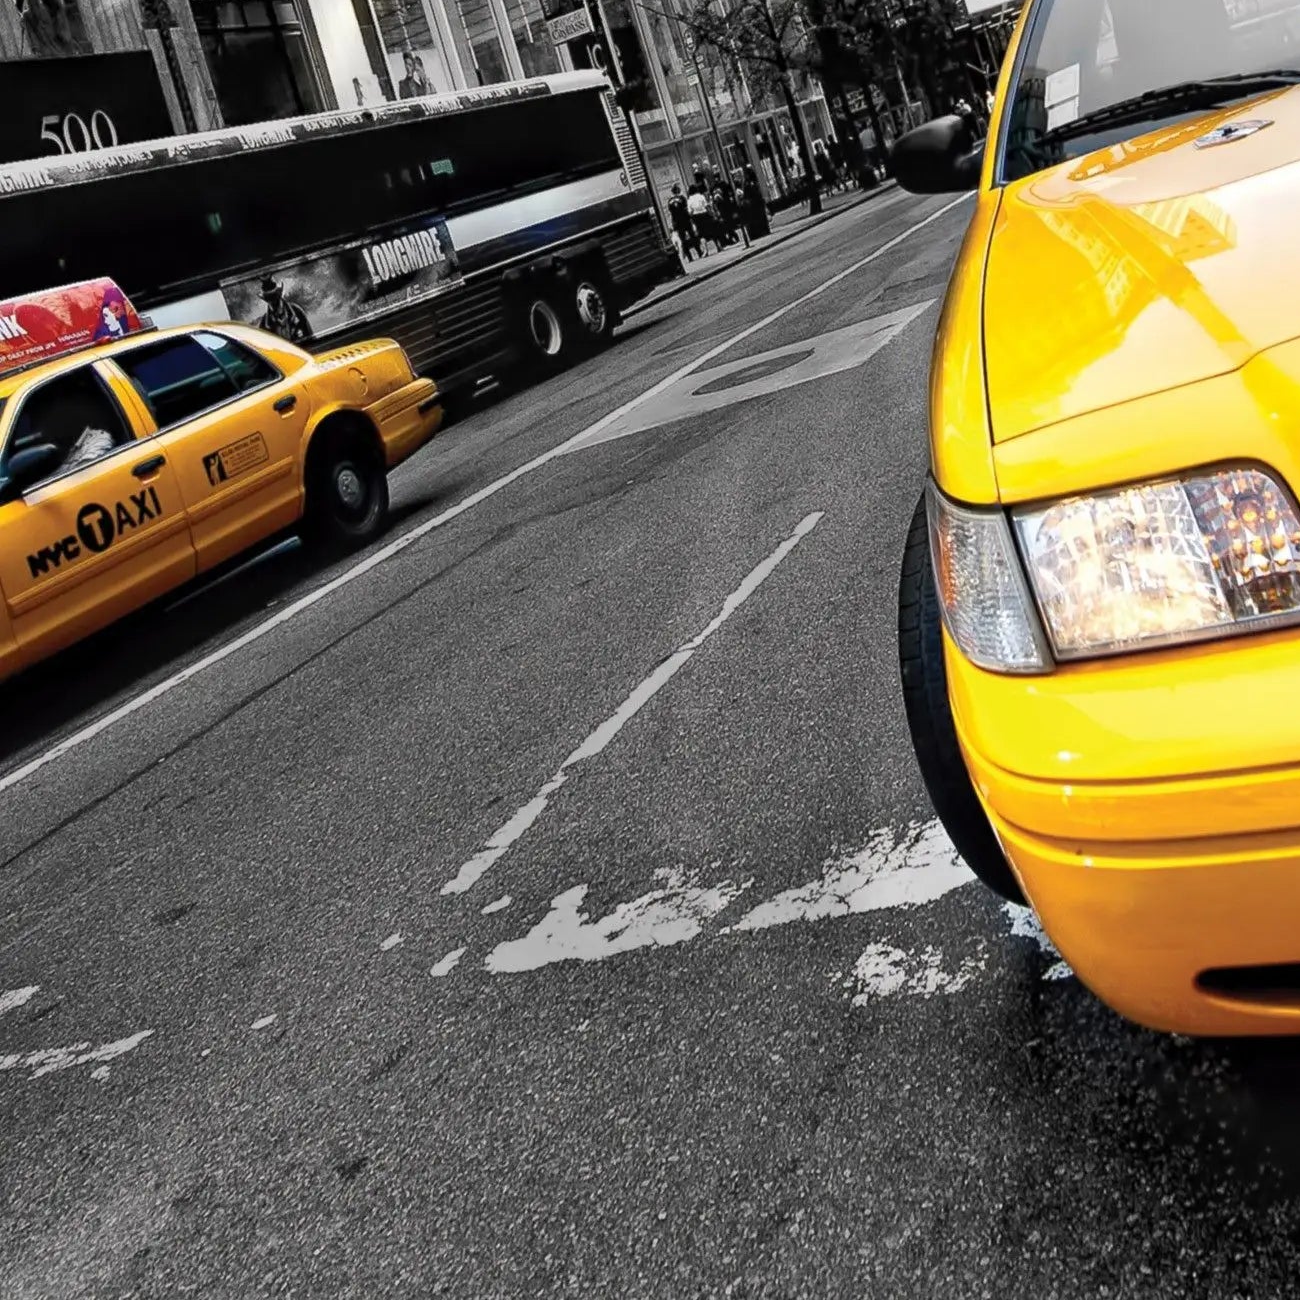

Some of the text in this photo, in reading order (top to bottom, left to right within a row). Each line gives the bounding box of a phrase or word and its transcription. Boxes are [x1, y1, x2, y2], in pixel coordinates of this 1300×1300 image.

[41, 110, 118, 154] 500
[361, 227, 446, 285] LONGMIRE
[26, 535, 81, 578] NYC
